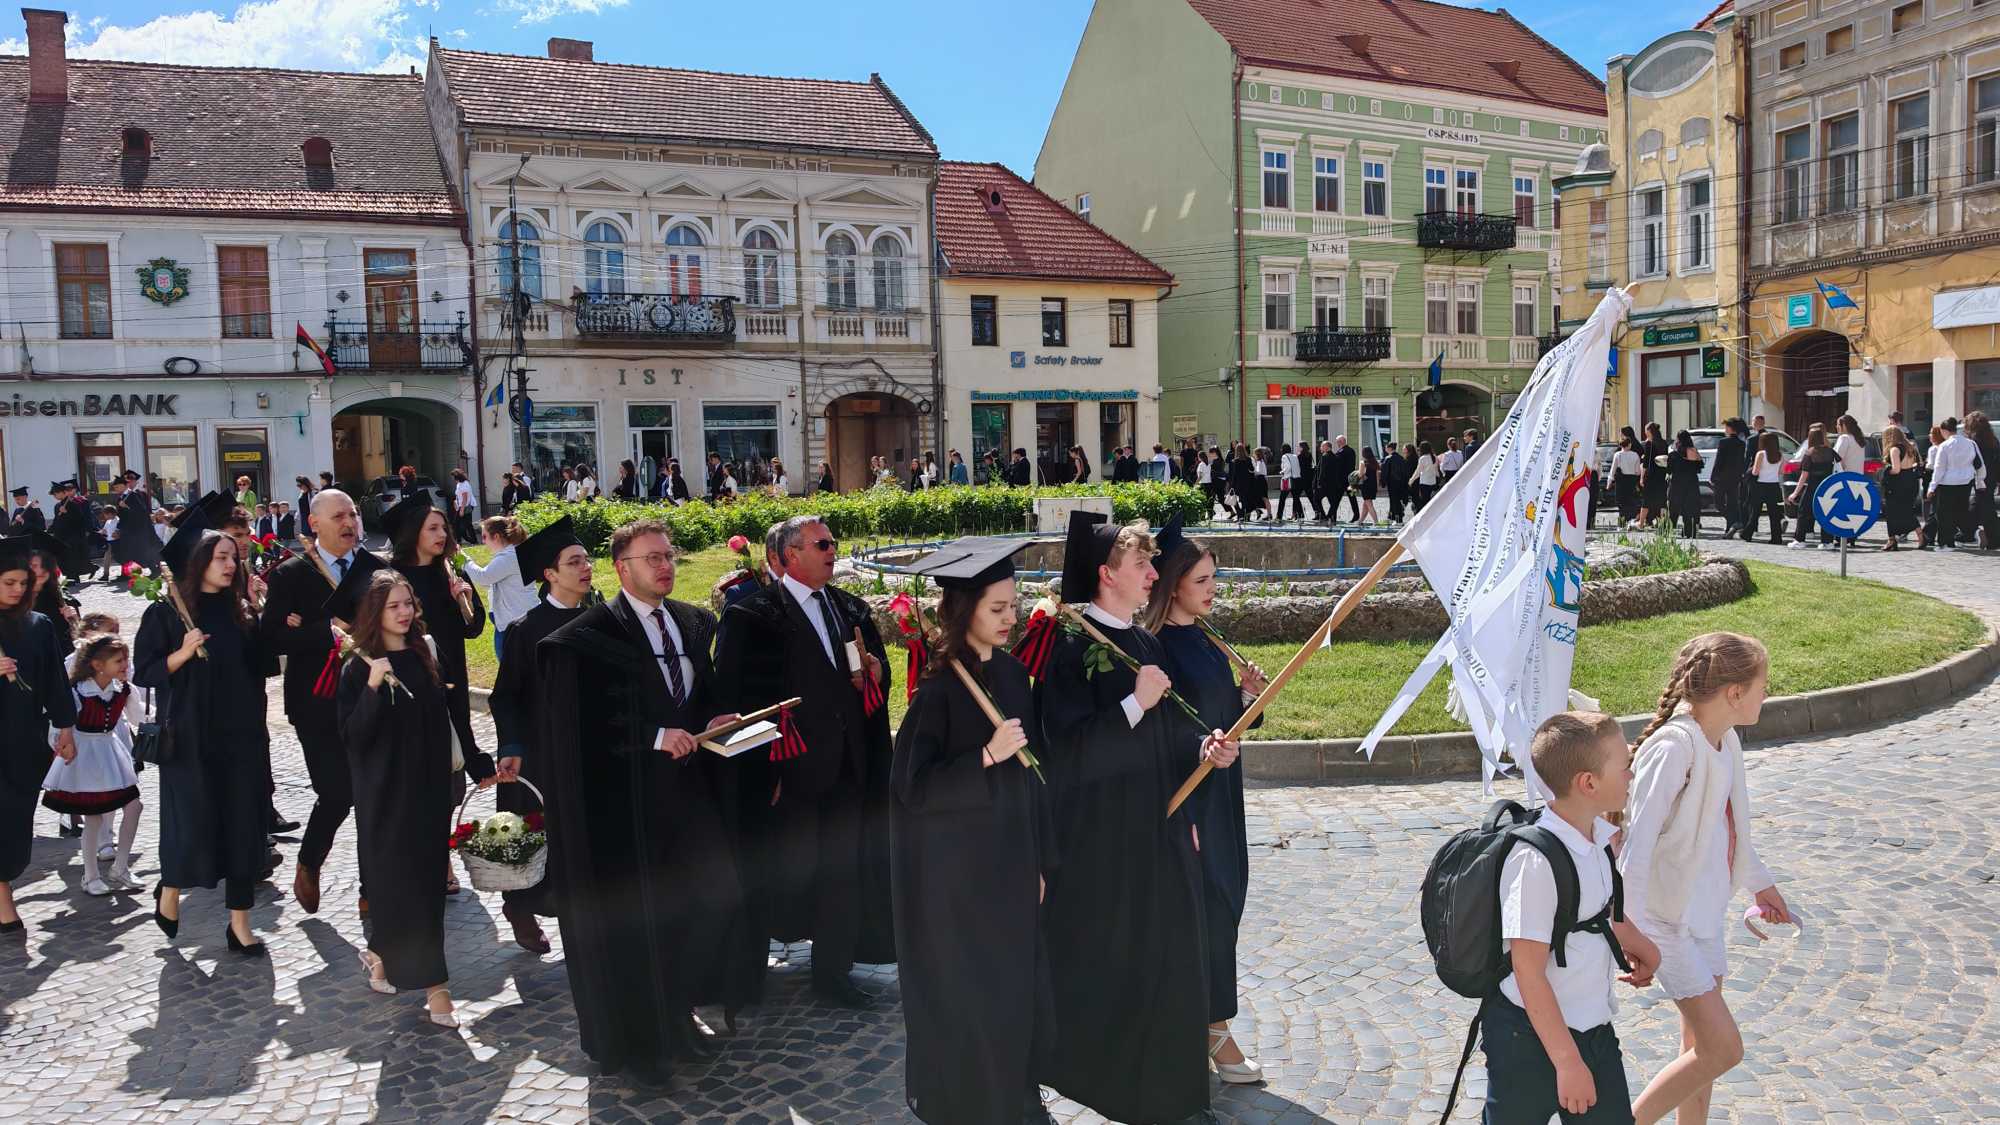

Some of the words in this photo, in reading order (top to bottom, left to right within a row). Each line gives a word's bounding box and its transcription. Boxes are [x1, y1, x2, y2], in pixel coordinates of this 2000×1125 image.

[1661, 331, 1694, 341] Groupama
[1034, 355, 1067, 366] Safety
[1070, 355, 1104, 365] Broker
[1286, 383, 1330, 399] Orange
[1333, 383, 1362, 396] store
[83, 394, 179, 416] BANK
[1551, 431, 1571, 481] 2021-2025
